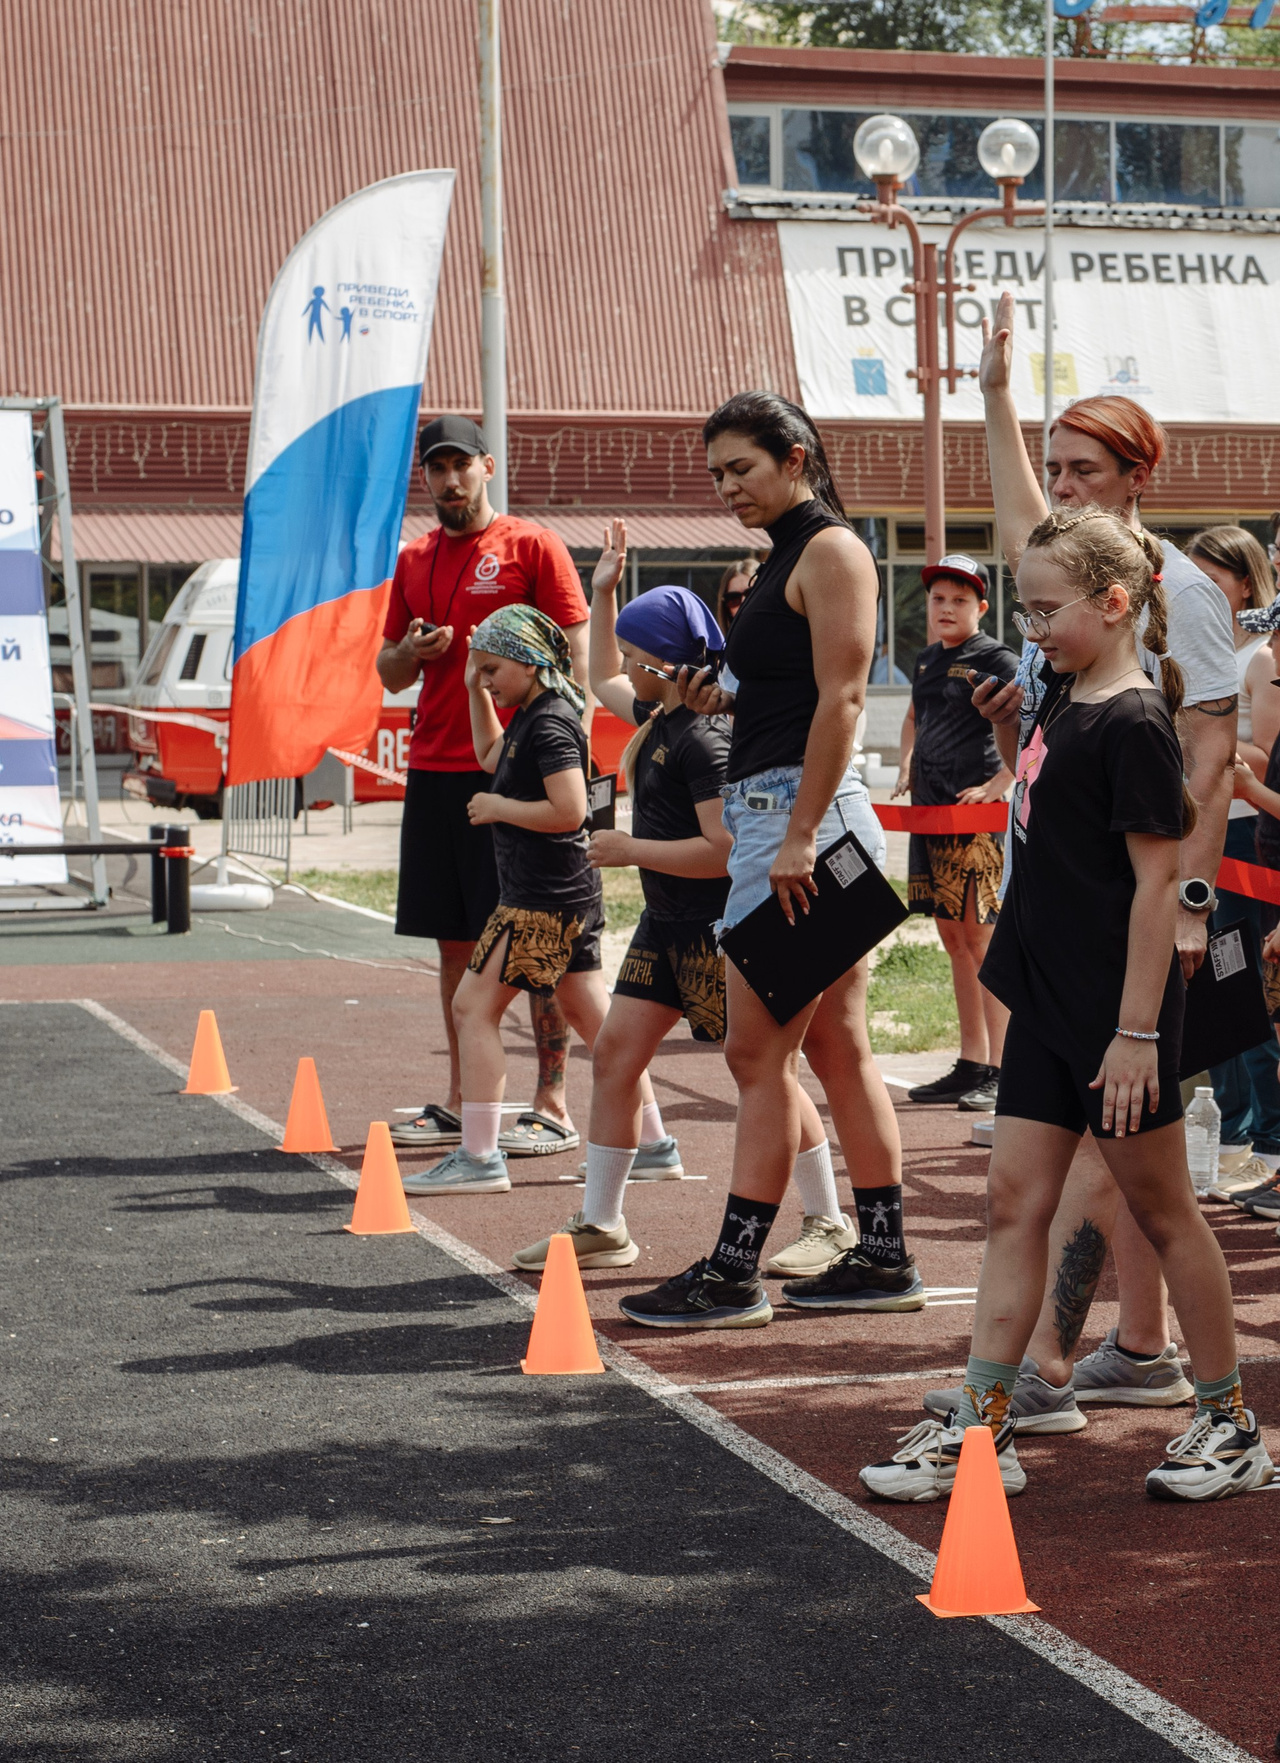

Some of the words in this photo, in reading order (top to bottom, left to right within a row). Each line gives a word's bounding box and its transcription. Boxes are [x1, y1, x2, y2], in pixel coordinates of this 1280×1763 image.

[1070, 252, 1269, 286] РЕБЕНКА
[336, 282, 409, 298] ПРИВЕДИ
[349, 294, 415, 310] РЕБЕНКА
[359, 307, 369, 318] В
[372, 308, 419, 323] СПОРТ
[844, 295, 870, 326] В
[885, 295, 1058, 331] СОТ!
[831, 865, 849, 887] STAFF
[1212, 951, 1225, 978] STAFF
[862, 1233, 900, 1250] EBASH
[719, 1242, 759, 1261] EBASH
